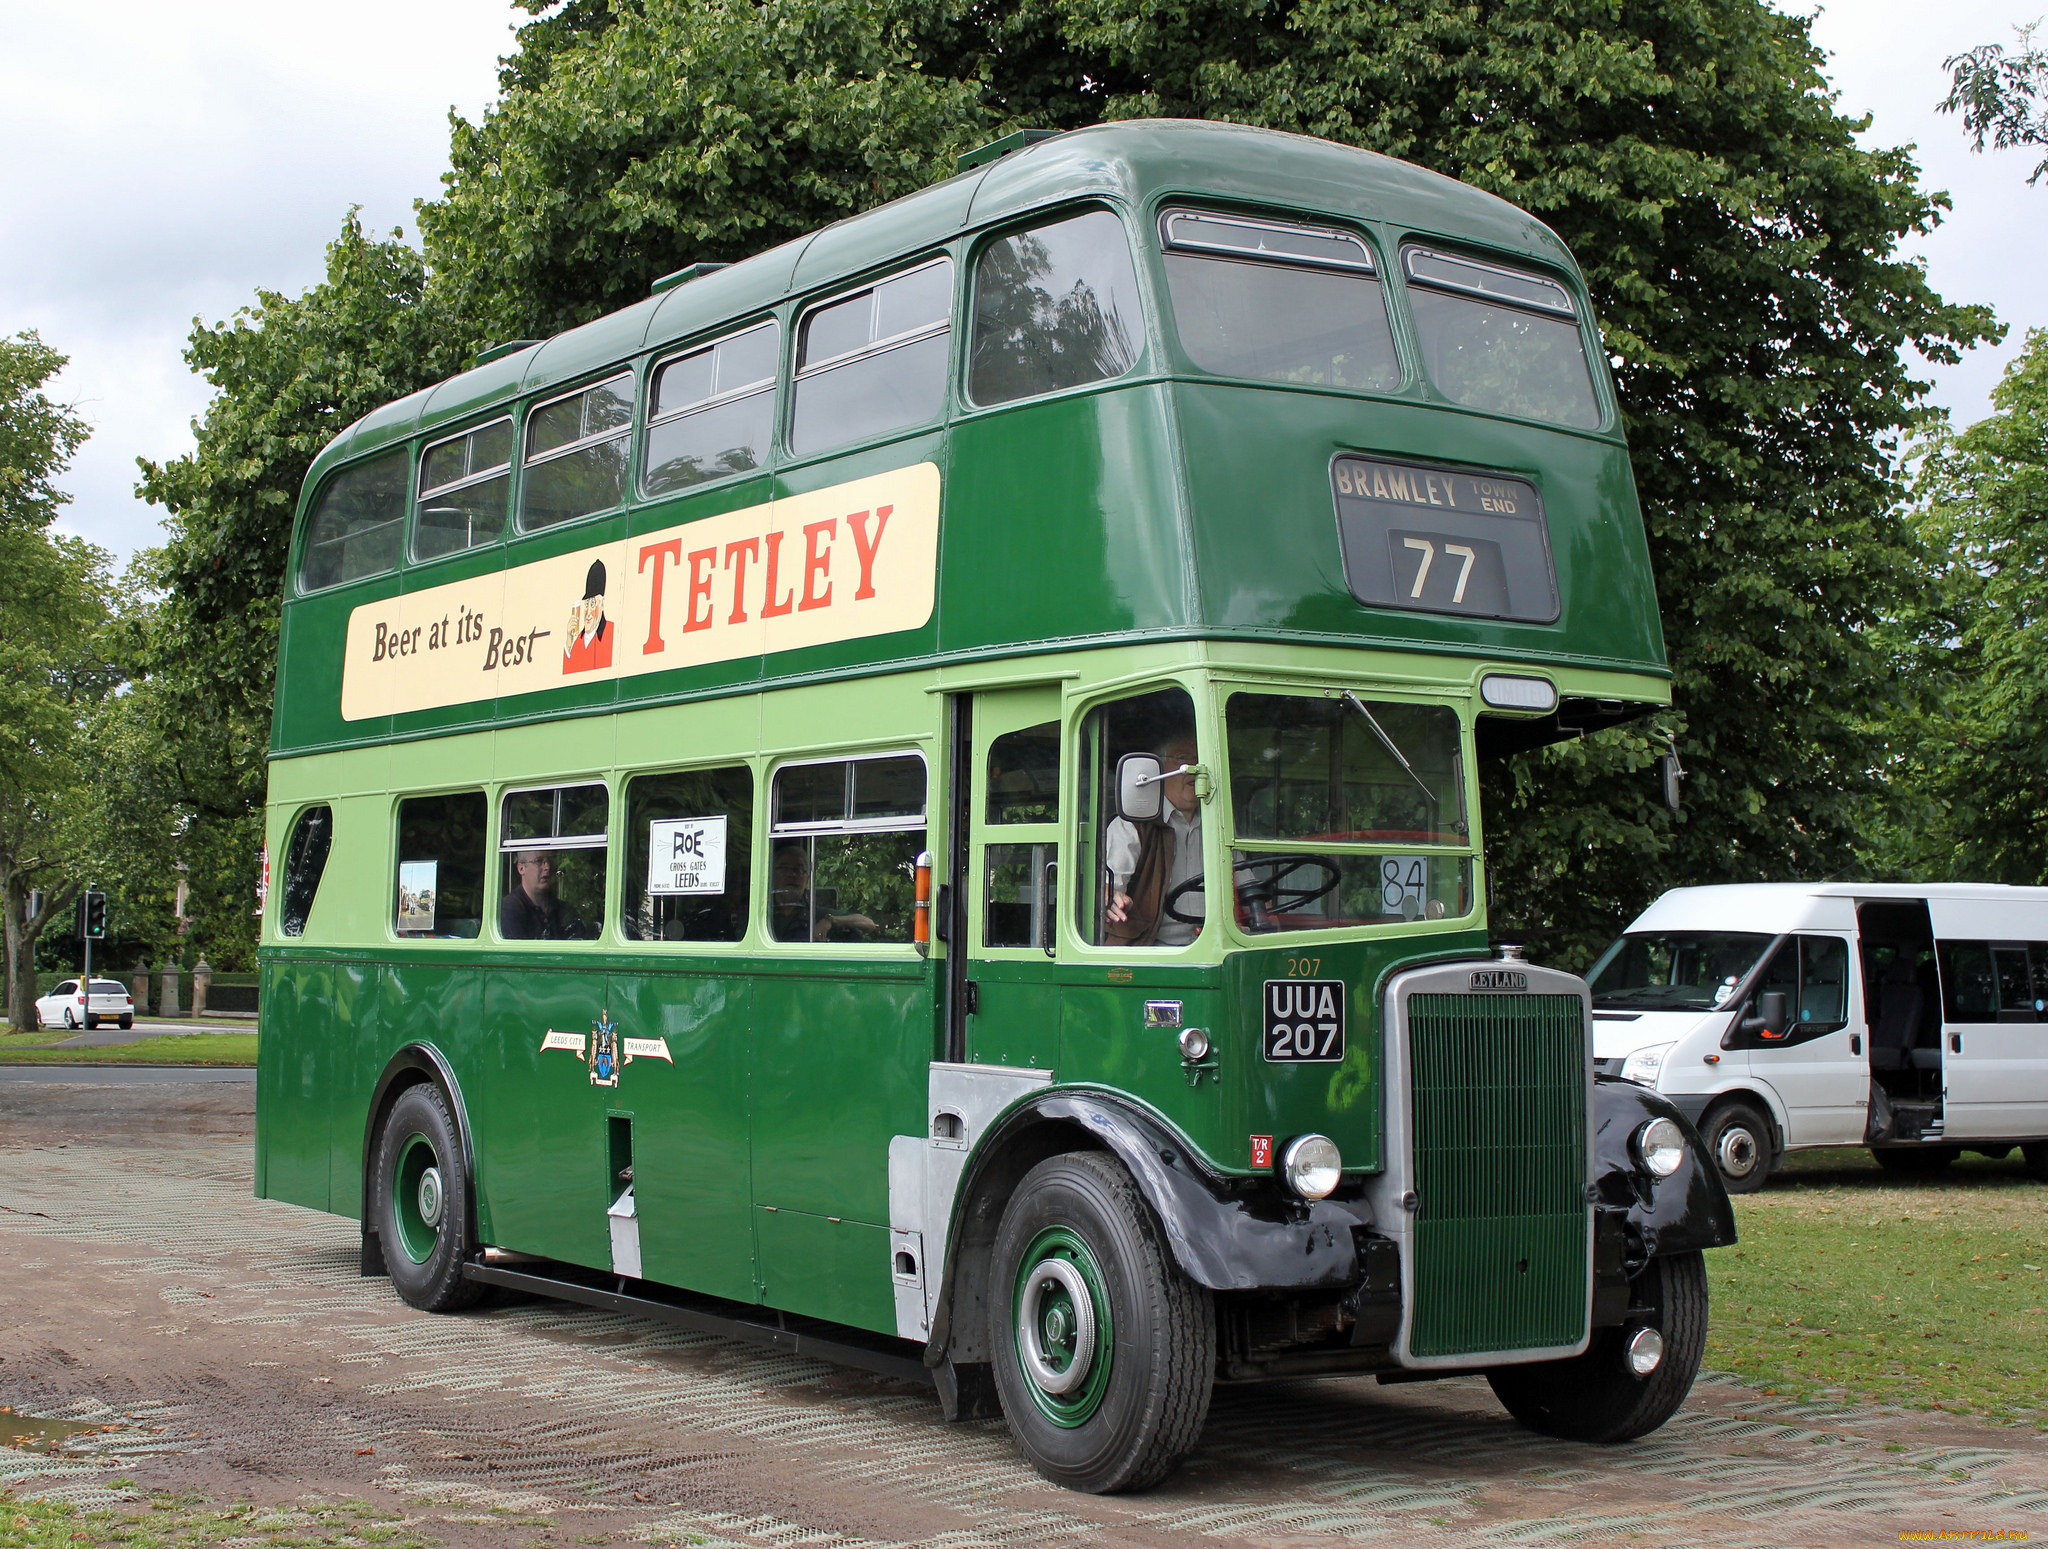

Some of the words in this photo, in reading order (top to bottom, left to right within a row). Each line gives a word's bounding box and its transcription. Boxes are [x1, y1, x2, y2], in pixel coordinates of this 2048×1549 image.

[1335, 463, 1456, 507] BRAMLEY
[1470, 480, 1518, 500] TOWN
[1480, 497, 1517, 514] END
[638, 505, 894, 656] TETLEY
[1403, 537, 1476, 604] 77
[372, 622, 421, 662] Beer
[428, 612, 450, 650] at
[455, 605, 484, 644] its
[483, 628, 551, 671] Best
[673, 829, 704, 860] ROE
[669, 862, 687, 872] CROSS
[689, 861, 706, 871] GATES
[675, 872, 700, 888] LEEDS
[1383, 860, 1424, 907] 84
[1288, 958, 1321, 977] 207
[1472, 971, 1526, 988] LEYLAND
[1271, 985, 1337, 1019] UUA
[550, 1035, 568, 1045] LEEDS
[569, 1037, 582, 1046] CITY
[626, 1041, 661, 1053] TRANSPORT
[1271, 1023, 1338, 1057] 207
[1252, 1138, 1268, 1150] T/R
[1256, 1151, 1264, 1164] 2
